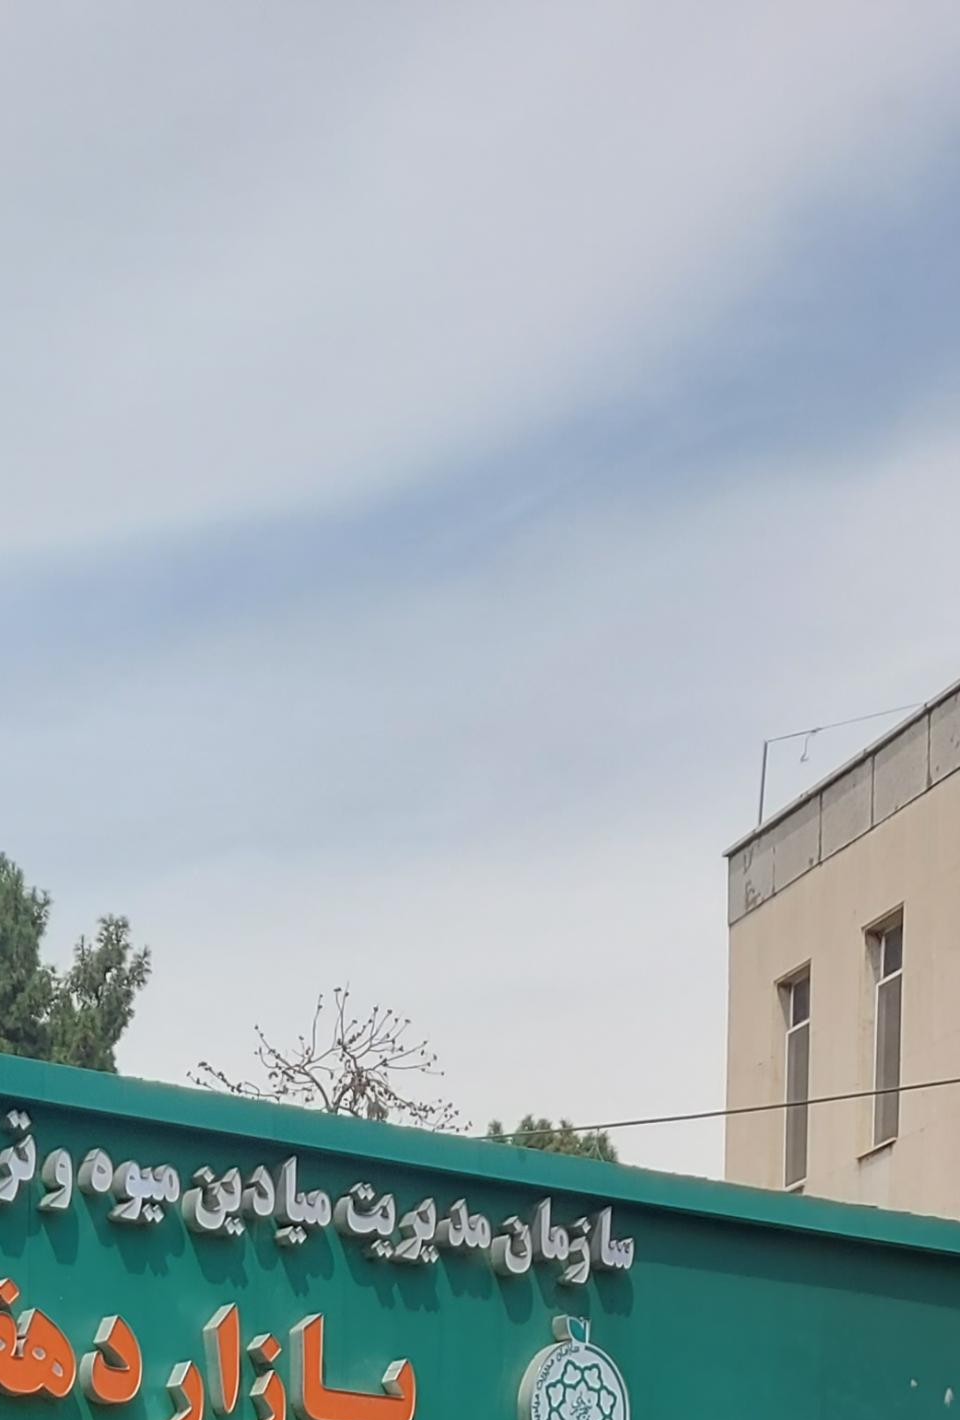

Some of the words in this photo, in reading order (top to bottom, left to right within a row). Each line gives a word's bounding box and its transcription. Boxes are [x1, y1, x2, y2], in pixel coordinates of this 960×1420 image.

[37, 1146, 74, 1212] و
[78, 1146, 181, 1225] میوه
[181, 1154, 332, 1247] میادین
[335, 1180, 492, 1265] مدیریت
[491, 1197, 635, 1287] سازمان
